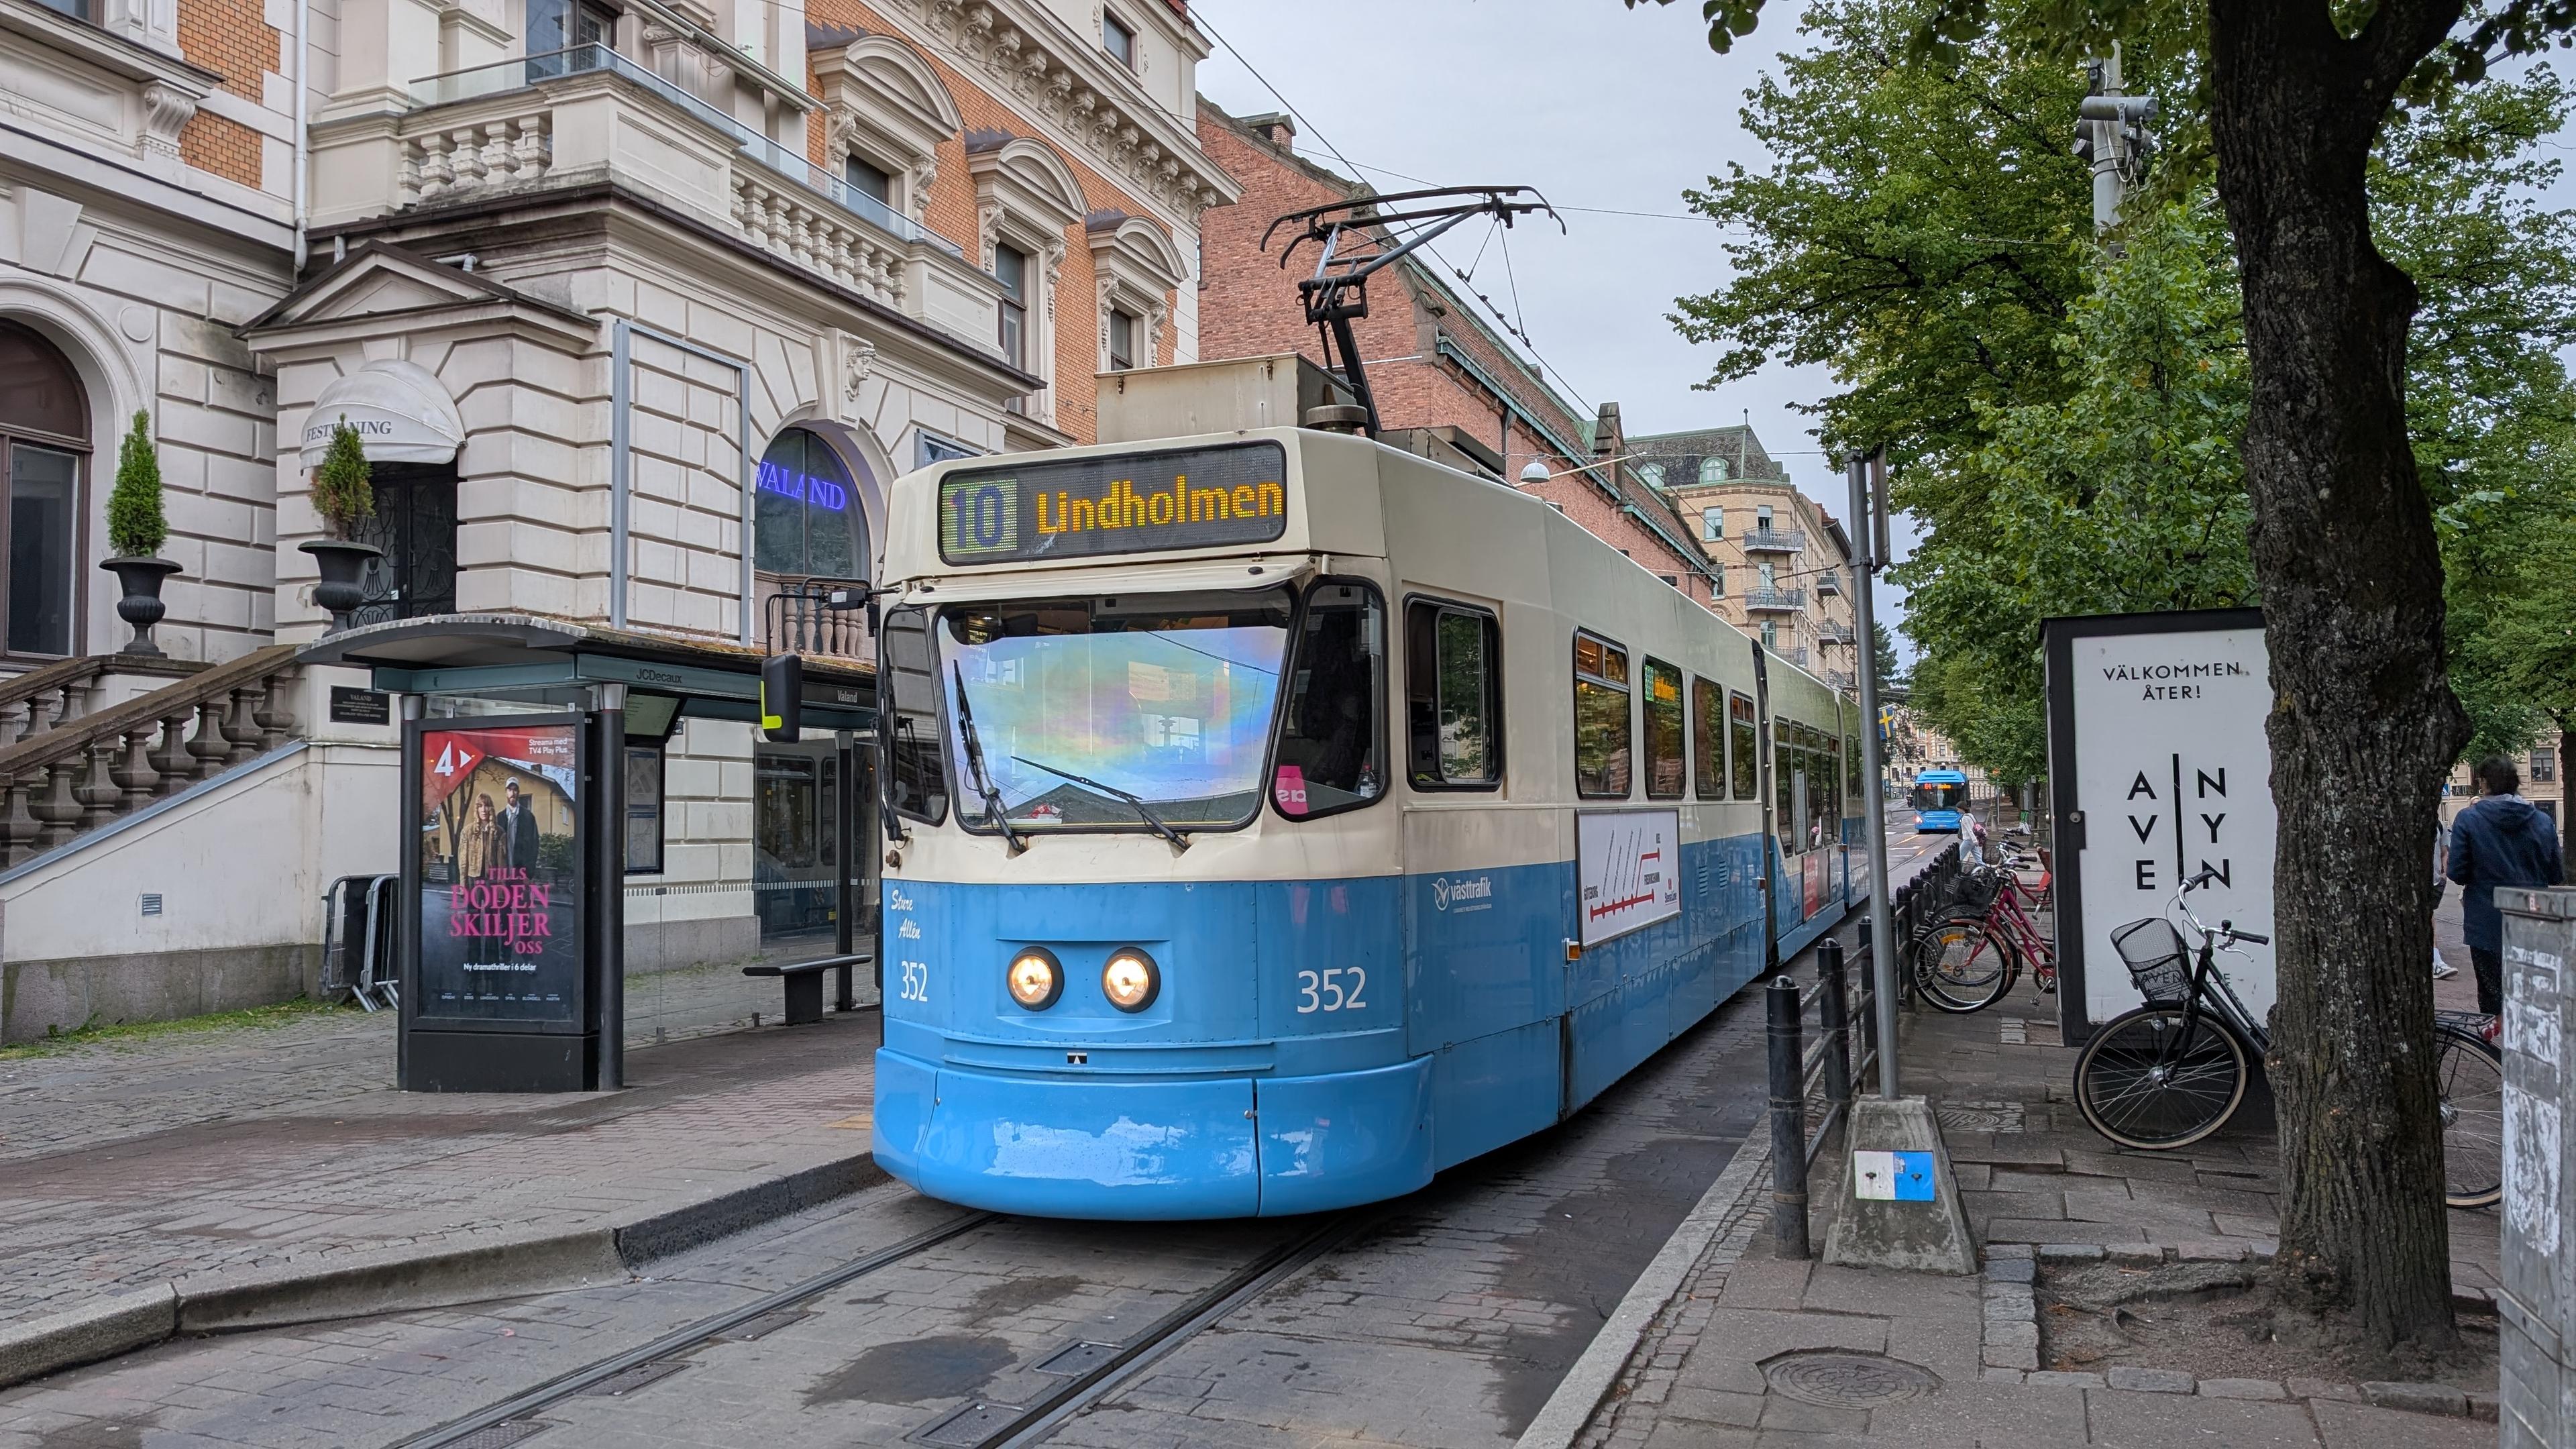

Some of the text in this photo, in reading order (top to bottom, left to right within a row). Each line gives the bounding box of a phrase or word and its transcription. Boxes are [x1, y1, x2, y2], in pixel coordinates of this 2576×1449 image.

[757, 461, 846, 510] VALAND
[949, 475, 1283, 547] 10 Lindholmen
[636, 668, 682, 683] JCDecaux
[2102, 662, 2240, 681] VÄLKOMMEN
[837, 690, 858, 703] Valand
[2143, 684, 2201, 700] ÅTER!
[434, 741, 454, 776] 4
[488, 867, 527, 880] TILLS
[451, 880, 550, 909] DÖDEN
[1451, 876, 1492, 901] västtrafik
[891, 890, 914, 911] Sture
[450, 912, 552, 945] SKILJER
[898, 918, 921, 940] Allén
[515, 941, 543, 954] OSS
[464, 963, 472, 971] Ny
[900, 960, 928, 1002] 352
[1297, 966, 1366, 1014] 352
